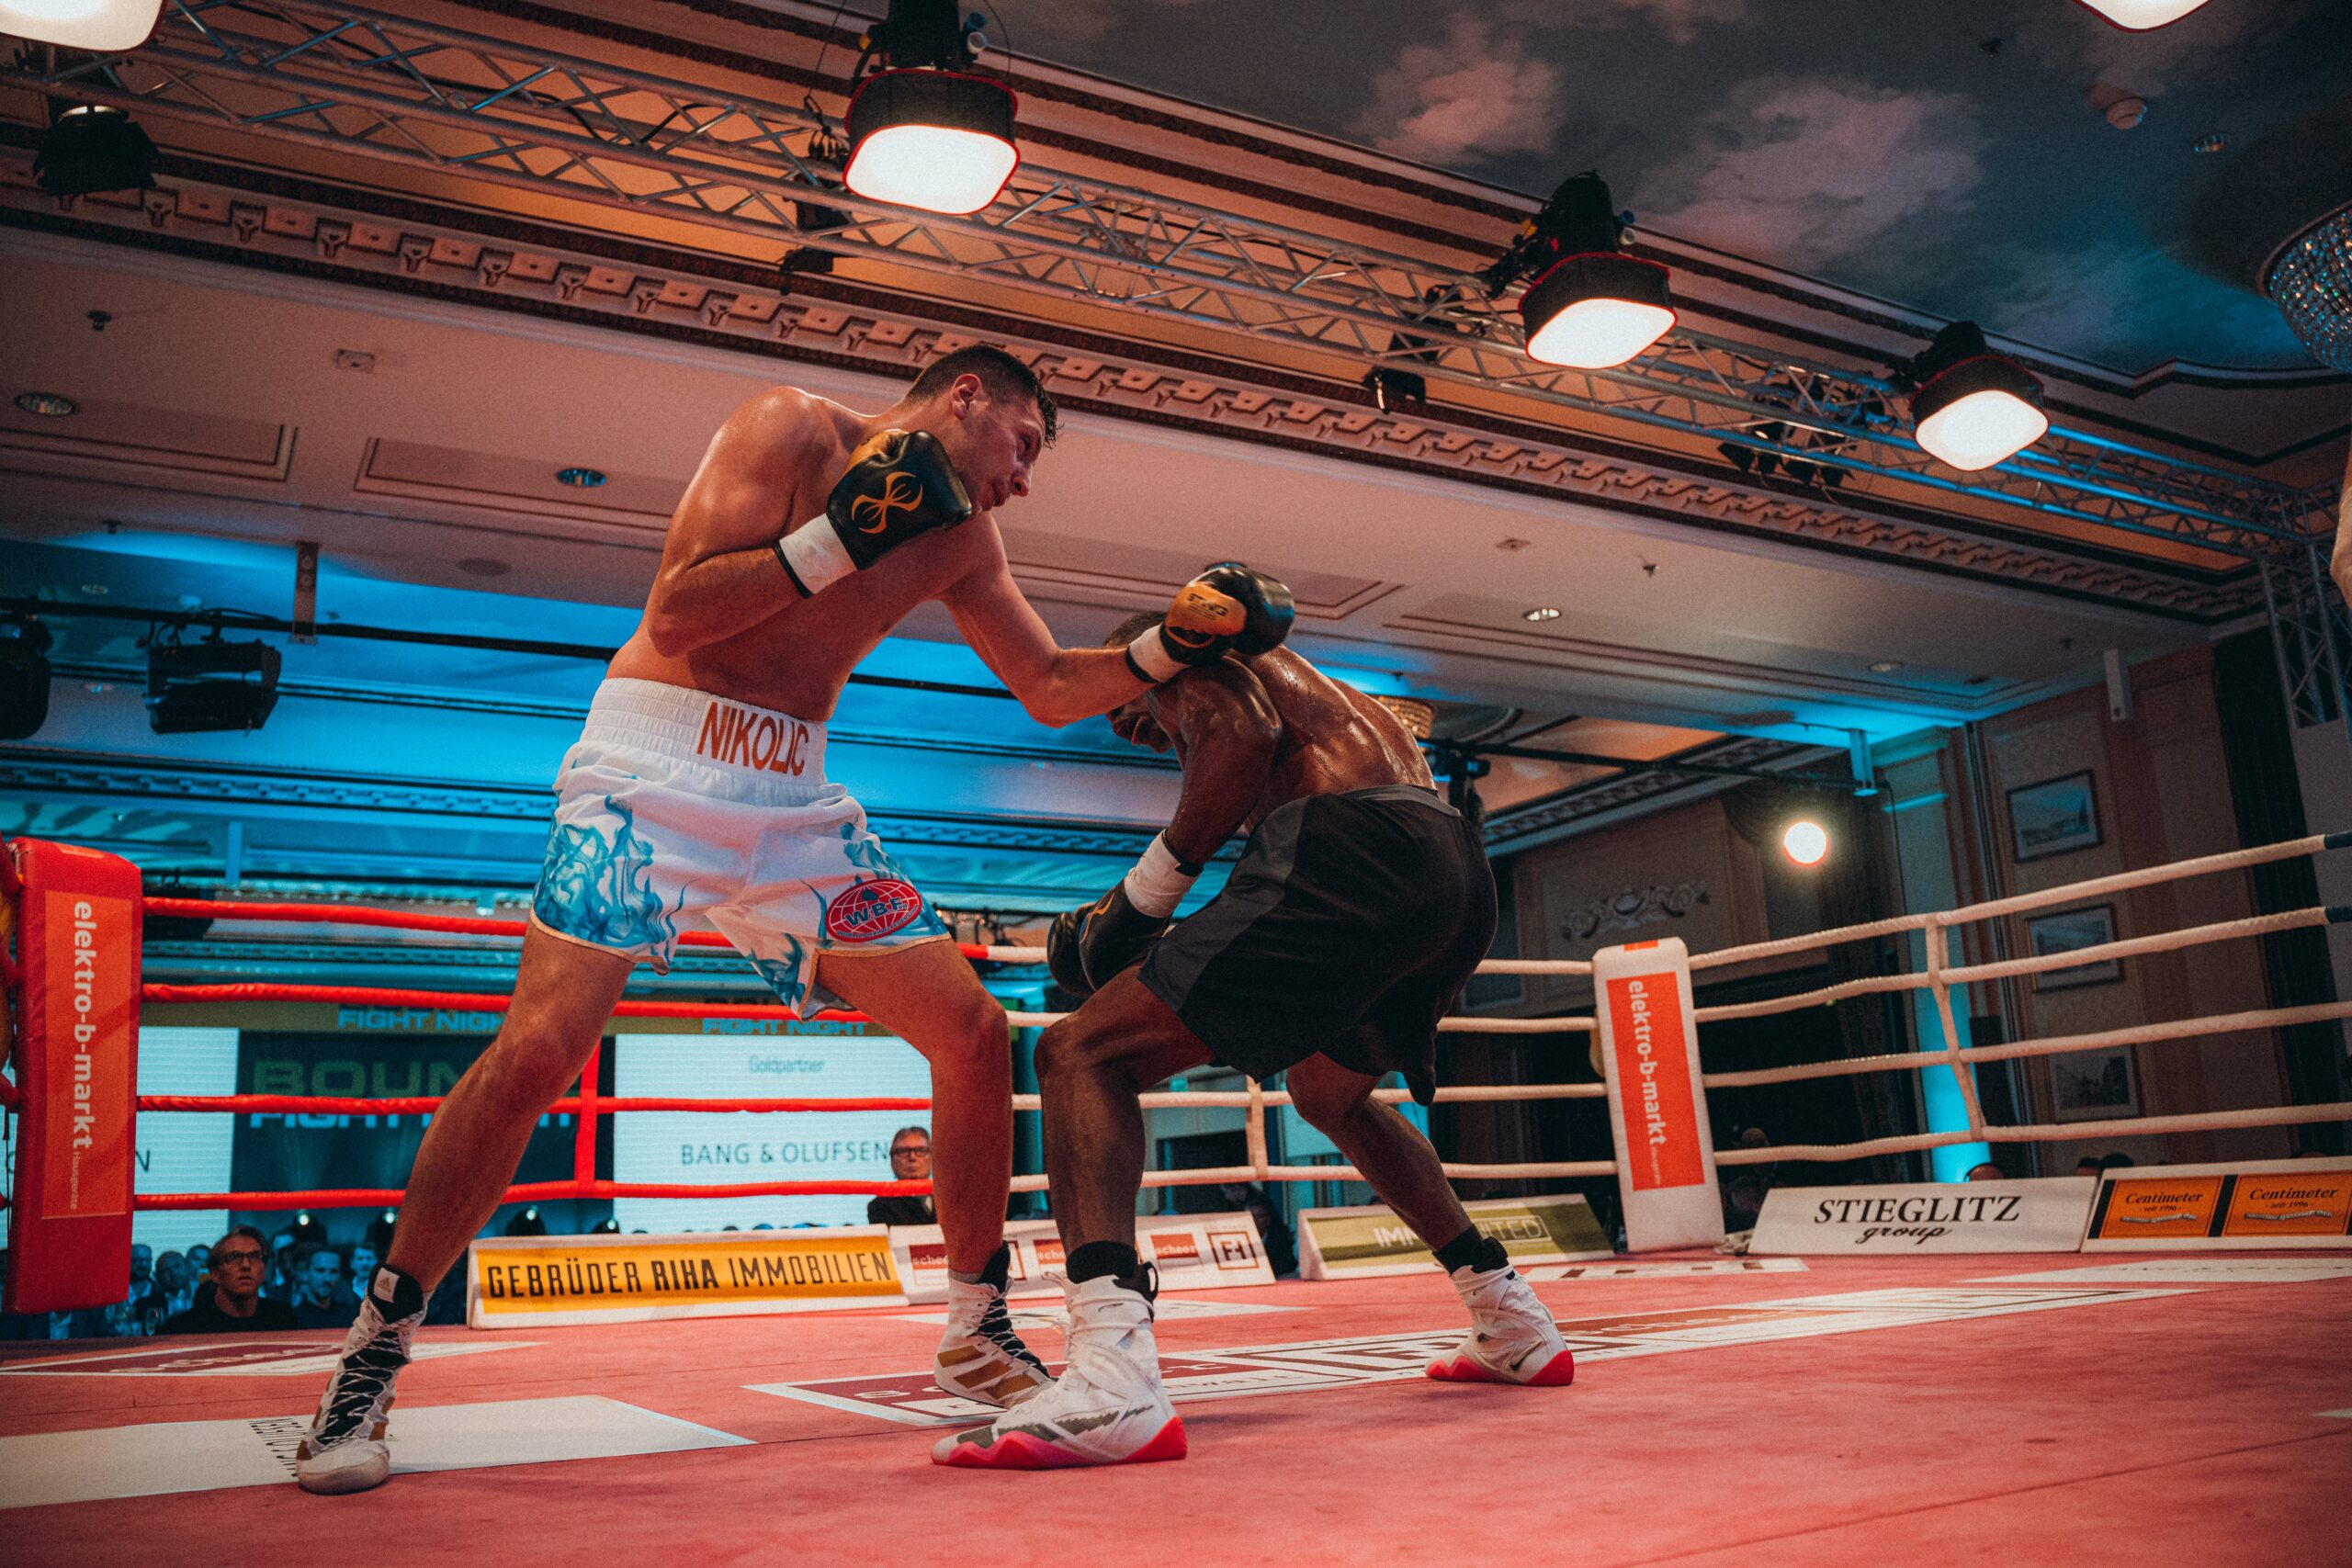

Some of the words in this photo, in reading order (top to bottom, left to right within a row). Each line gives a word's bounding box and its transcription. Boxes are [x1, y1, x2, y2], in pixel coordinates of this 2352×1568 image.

[697, 702, 809, 776] NIKOLIC
[74, 901, 96, 1149] elektro-b-markt
[337, 1009, 432, 1030] FIGHT
[435, 1011, 507, 1032] NIGH
[703, 1018, 778, 1034] FIGHT
[787, 1019, 865, 1035] NIGHT
[748, 1055, 825, 1074] Goldpartner
[1629, 980, 1667, 1145] elektro-b-markt
[681, 1144, 750, 1166] BANG
[761, 1144, 775, 1163] &
[783, 1141, 889, 1163] OLUFSEN
[2125, 1192, 2204, 1204] Centimeter
[2250, 1187, 2338, 1201] Centimeter
[1815, 1195, 2022, 1224] STIEGLITZ
[1855, 1226, 1953, 1245] group
[487, 1258, 642, 1299] GEBRÜDER
[651, 1258, 719, 1292] RIHA
[729, 1252, 892, 1288] IMMOBILIEN
